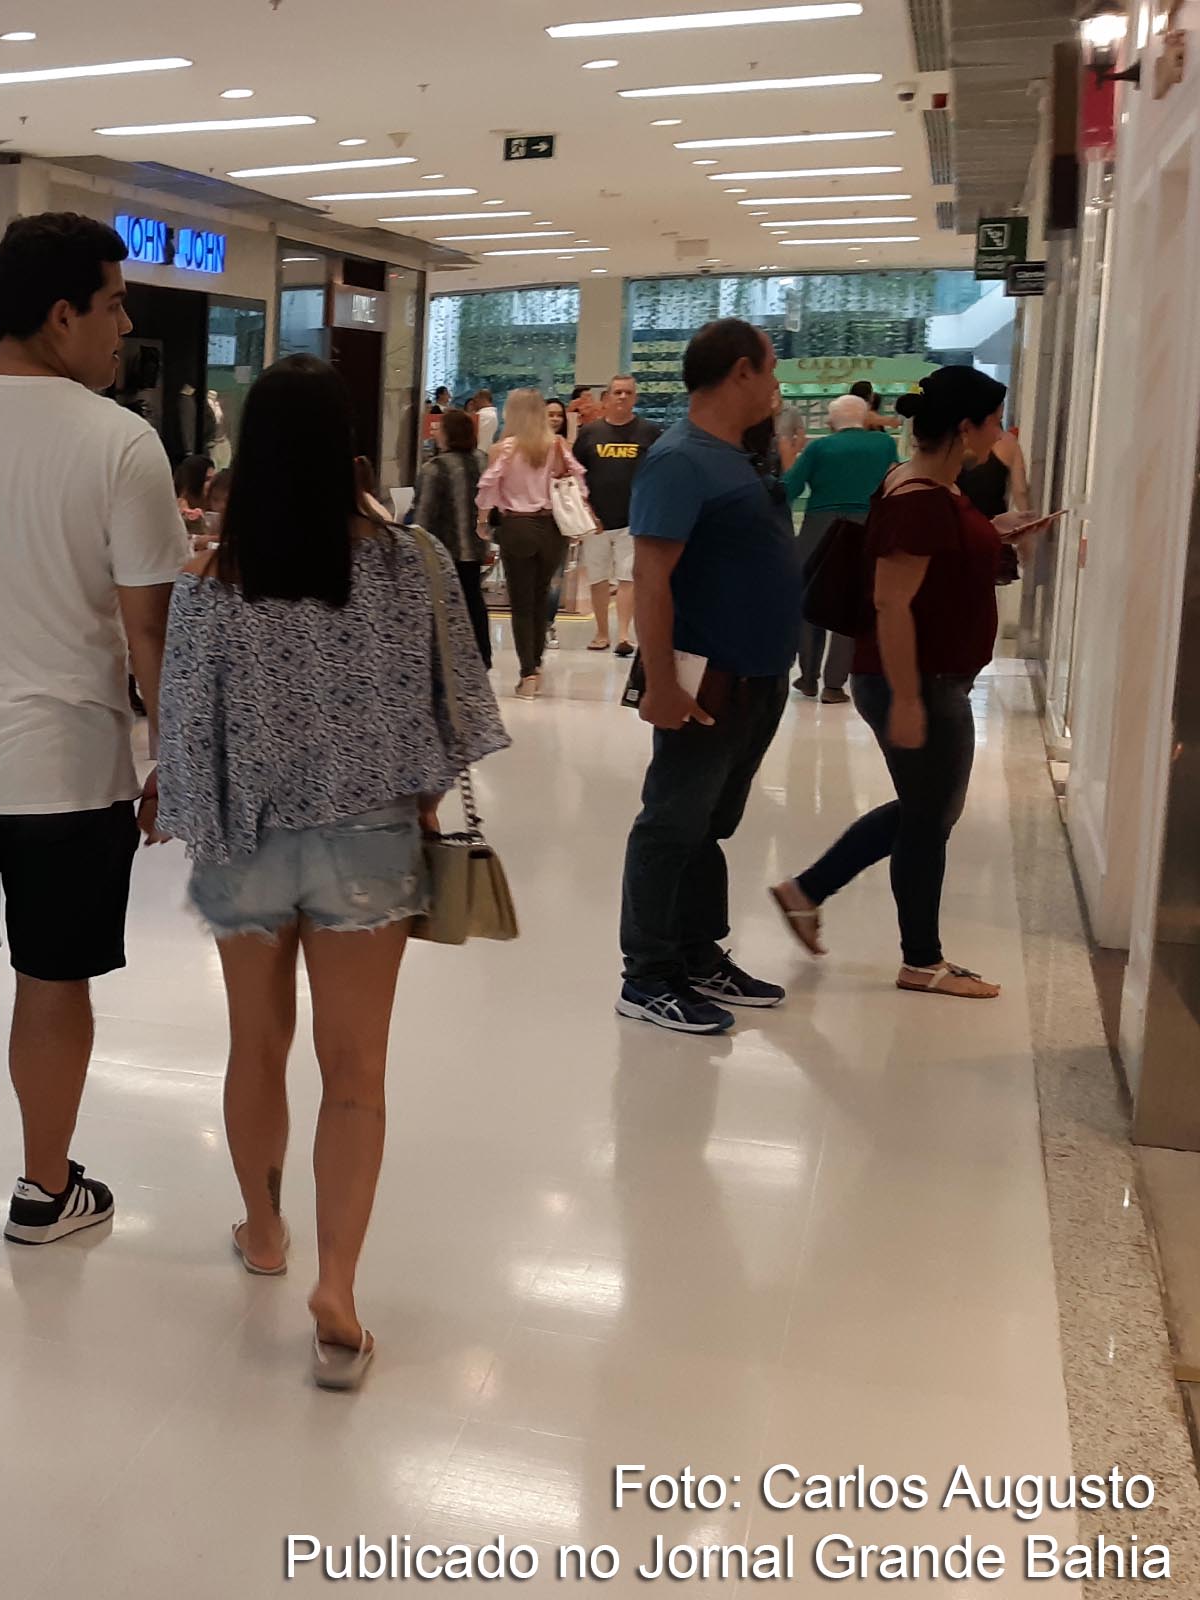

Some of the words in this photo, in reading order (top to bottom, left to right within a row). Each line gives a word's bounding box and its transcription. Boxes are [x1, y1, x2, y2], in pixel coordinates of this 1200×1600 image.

[114, 214, 168, 264] JOHN
[174, 227, 226, 273] JOHN
[596, 443, 640, 458] VANS
